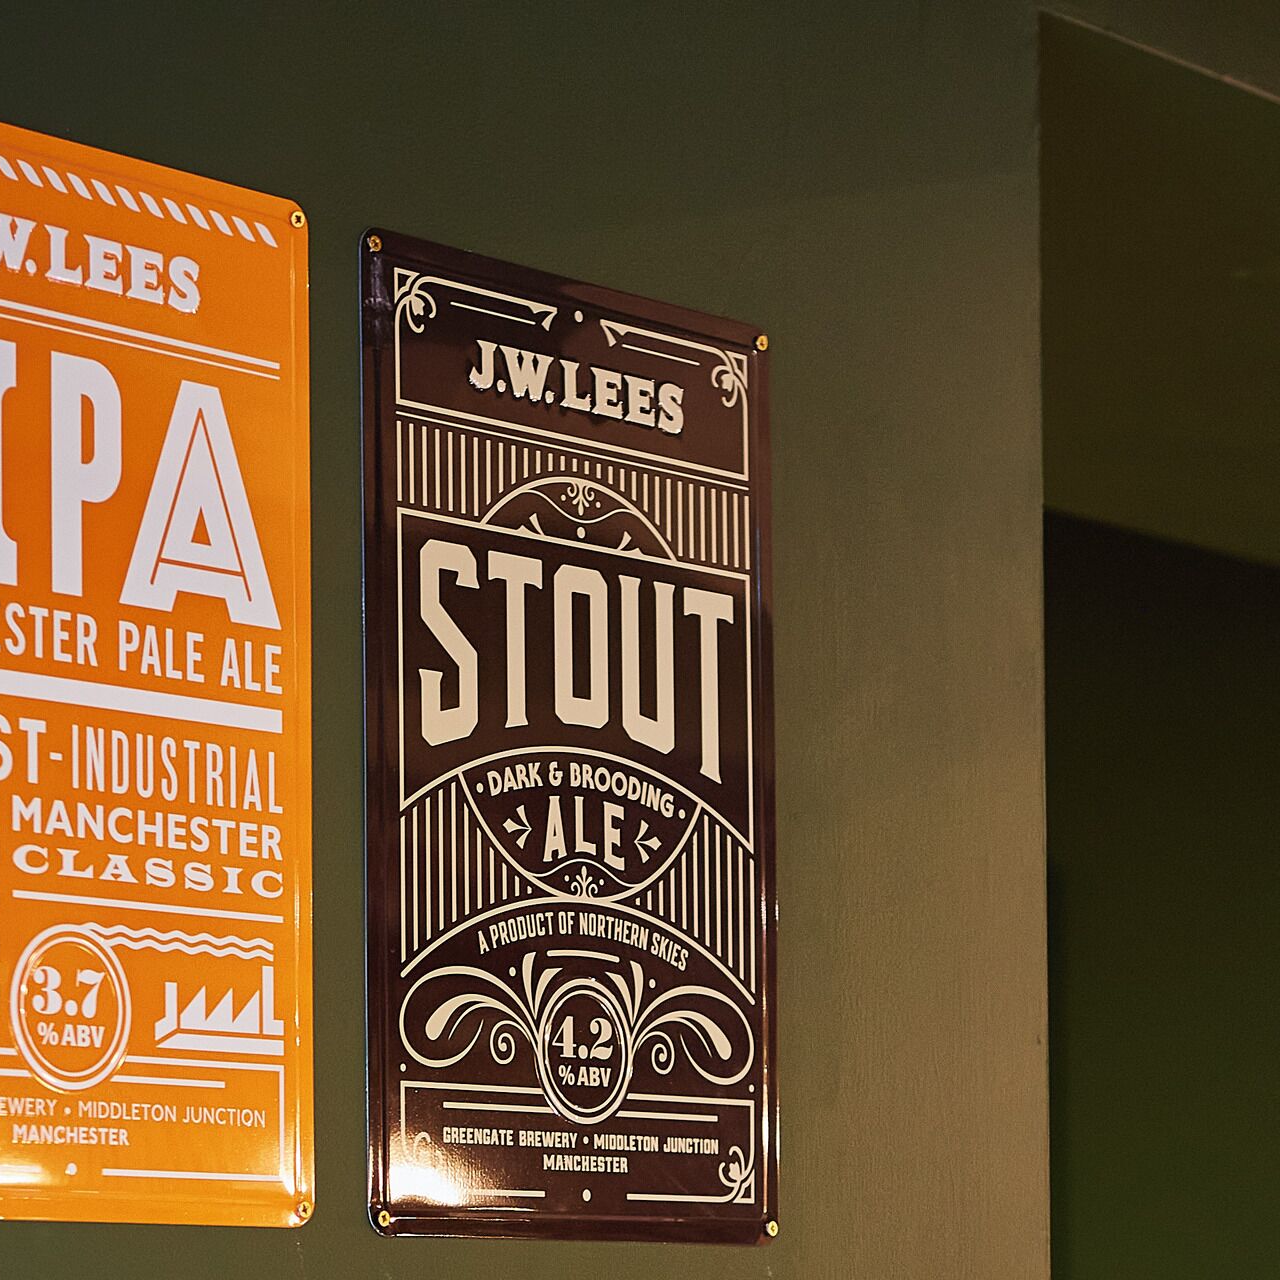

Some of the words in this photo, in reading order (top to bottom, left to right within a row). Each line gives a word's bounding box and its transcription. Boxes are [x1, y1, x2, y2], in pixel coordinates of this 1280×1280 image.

[469, 339, 684, 435] J.W.LEES
[118, 621, 206, 683] PALE
[221, 640, 283, 695] ALE
[419, 538, 735, 784] STOUT
[487, 762, 542, 796] DARK
[548, 763, 563, 786] &
[569, 762, 676, 818] BROODING
[11, 795, 283, 861] MANCHESTER
[543, 796, 626, 871] ALE
[12, 844, 284, 898] CLASSIC
[477, 930, 489, 954] A
[491, 912, 554, 946] PRODUCT
[558, 911, 574, 935] OF
[579, 911, 650, 952] NORTHERN
[650, 932, 689, 971] SKIES
[32, 965, 107, 1018] 3.7
[552, 1015, 615, 1060] 4.2
[12, 1125, 130, 1147] MANCHESTER
[78, 1100, 177, 1123] MIDDLETON
[181, 1105, 266, 1128] JUNCTION
[442, 1126, 514, 1147] GREENGATE
[519, 1130, 578, 1149] BREWERY
[593, 1134, 659, 1152] MIDDLETON
[663, 1136, 719, 1155] JUNCTION
[543, 1154, 628, 1173] MANCHESTER
